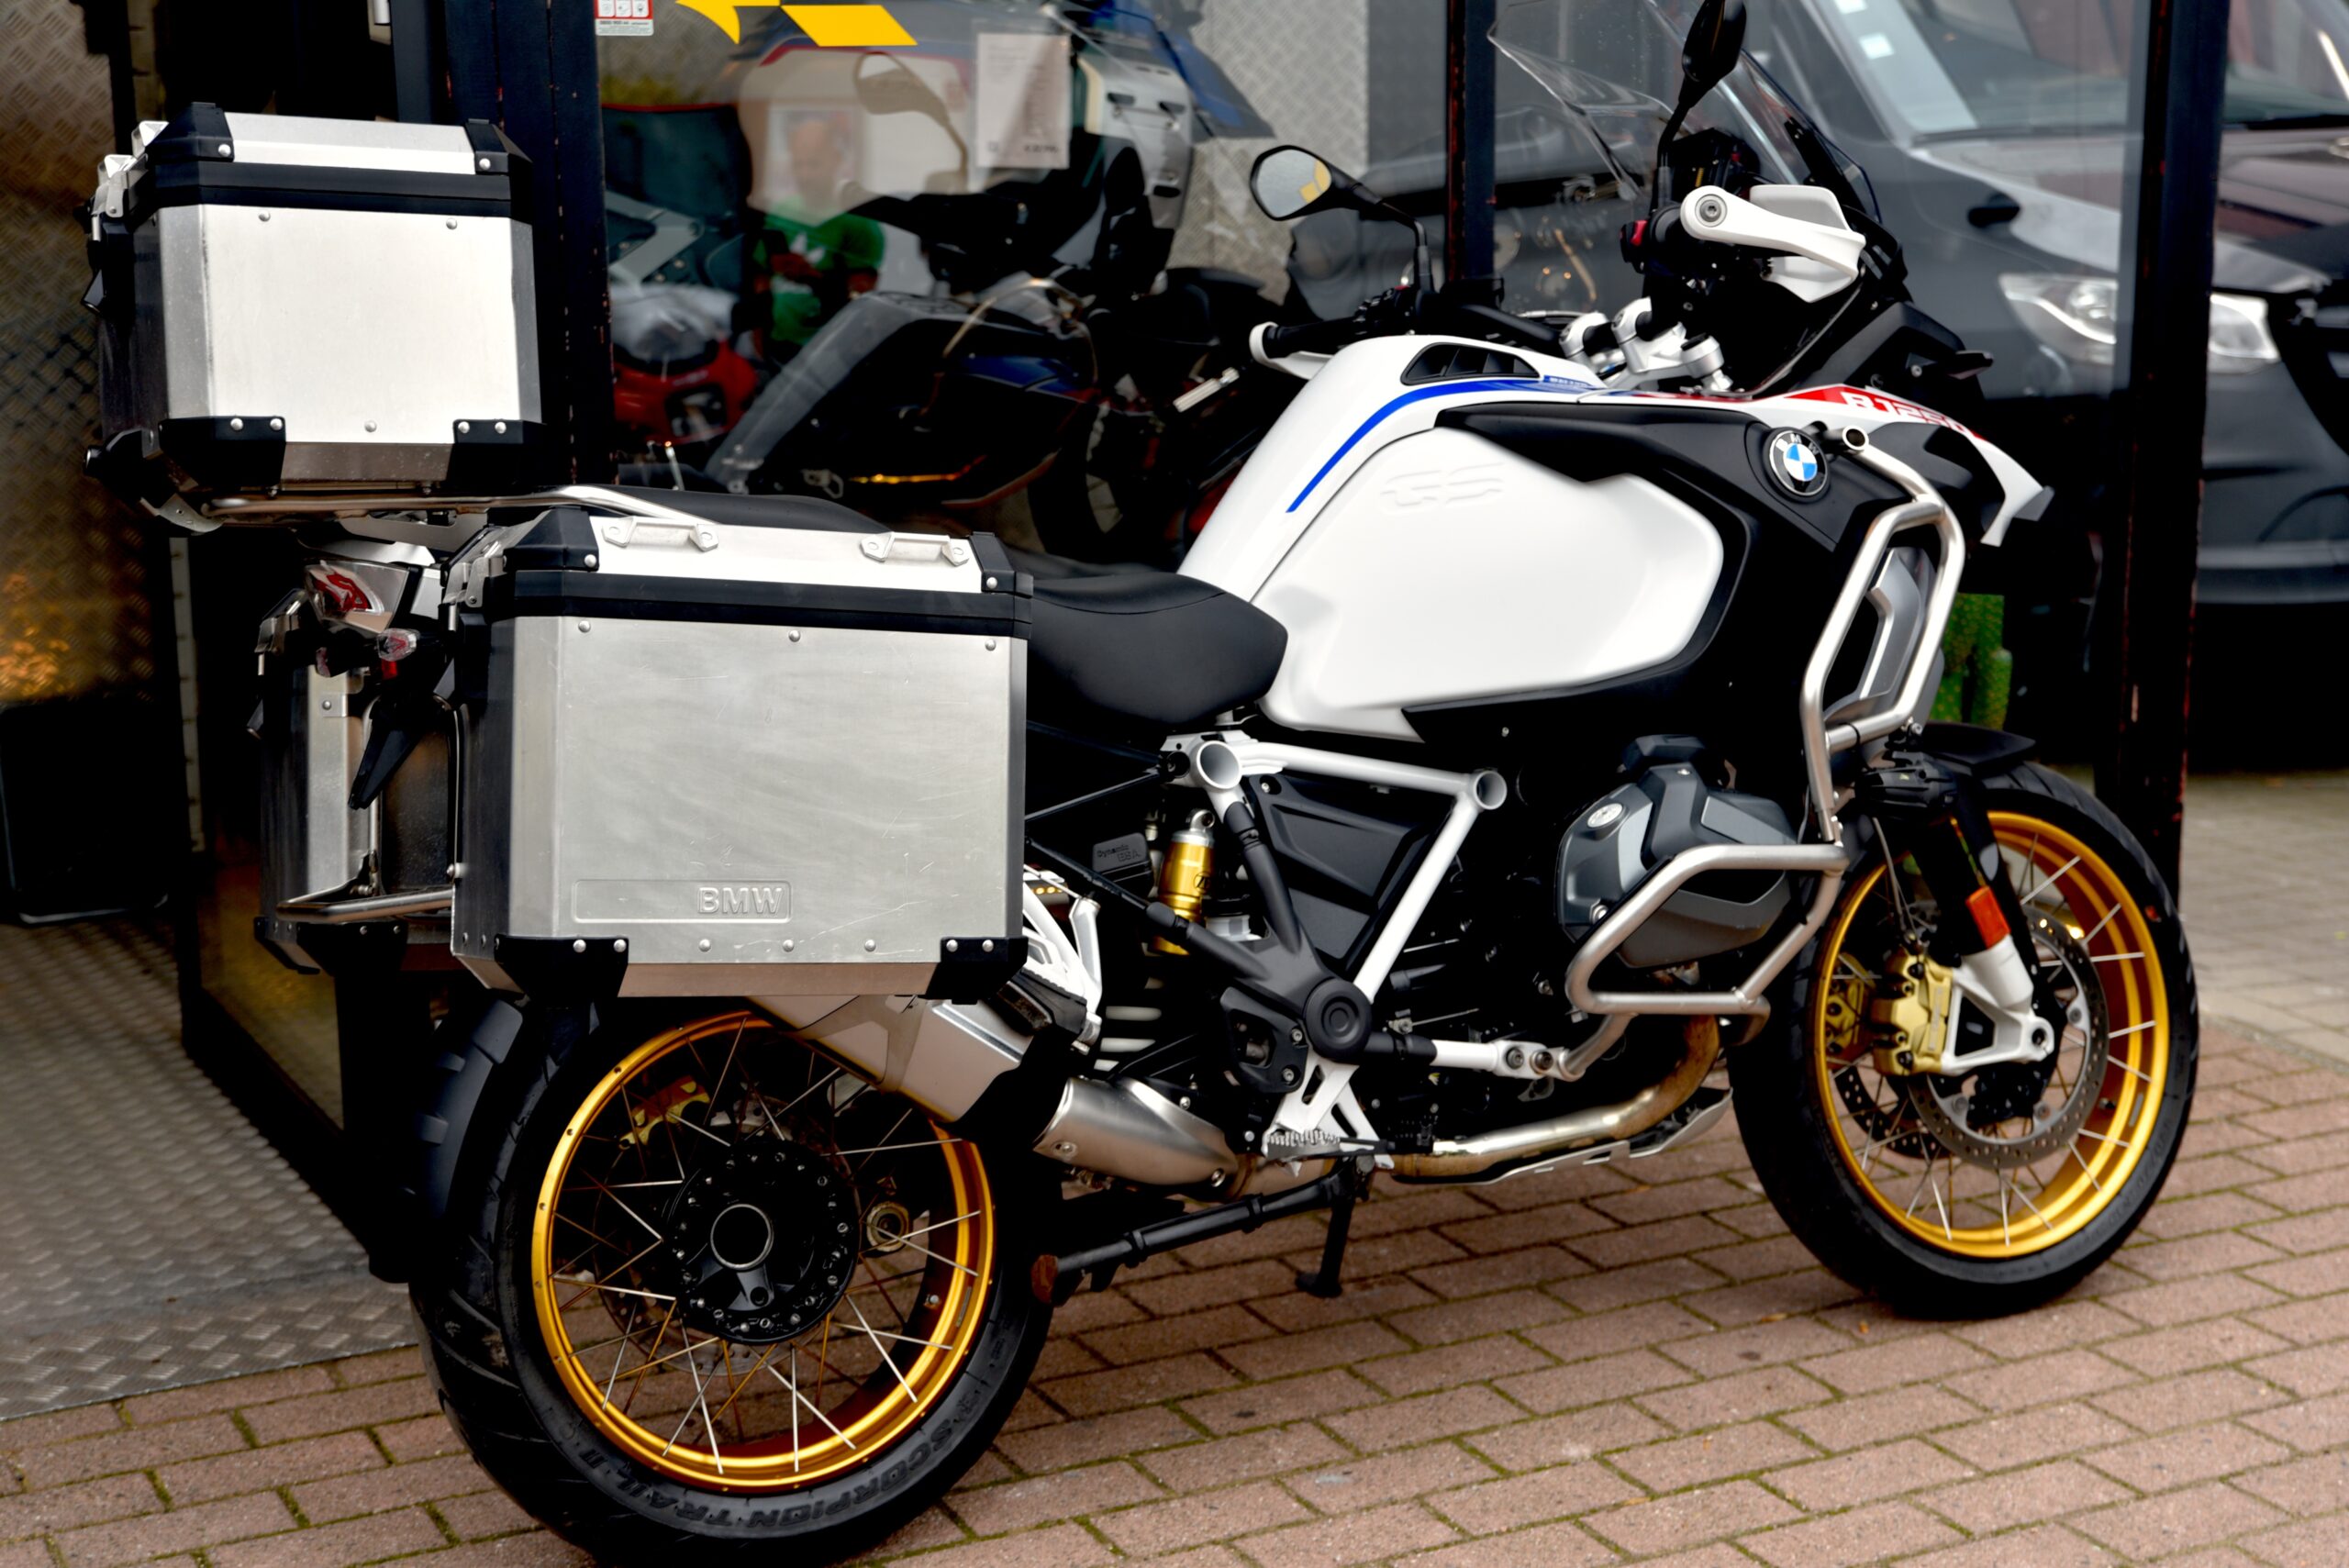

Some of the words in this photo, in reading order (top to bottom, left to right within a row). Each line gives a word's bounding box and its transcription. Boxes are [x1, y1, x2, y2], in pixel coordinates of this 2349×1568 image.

[697, 886, 783, 915] BMW
[617, 1469, 732, 1526] TRAIL
[746, 1418, 954, 1528] SCORPION
